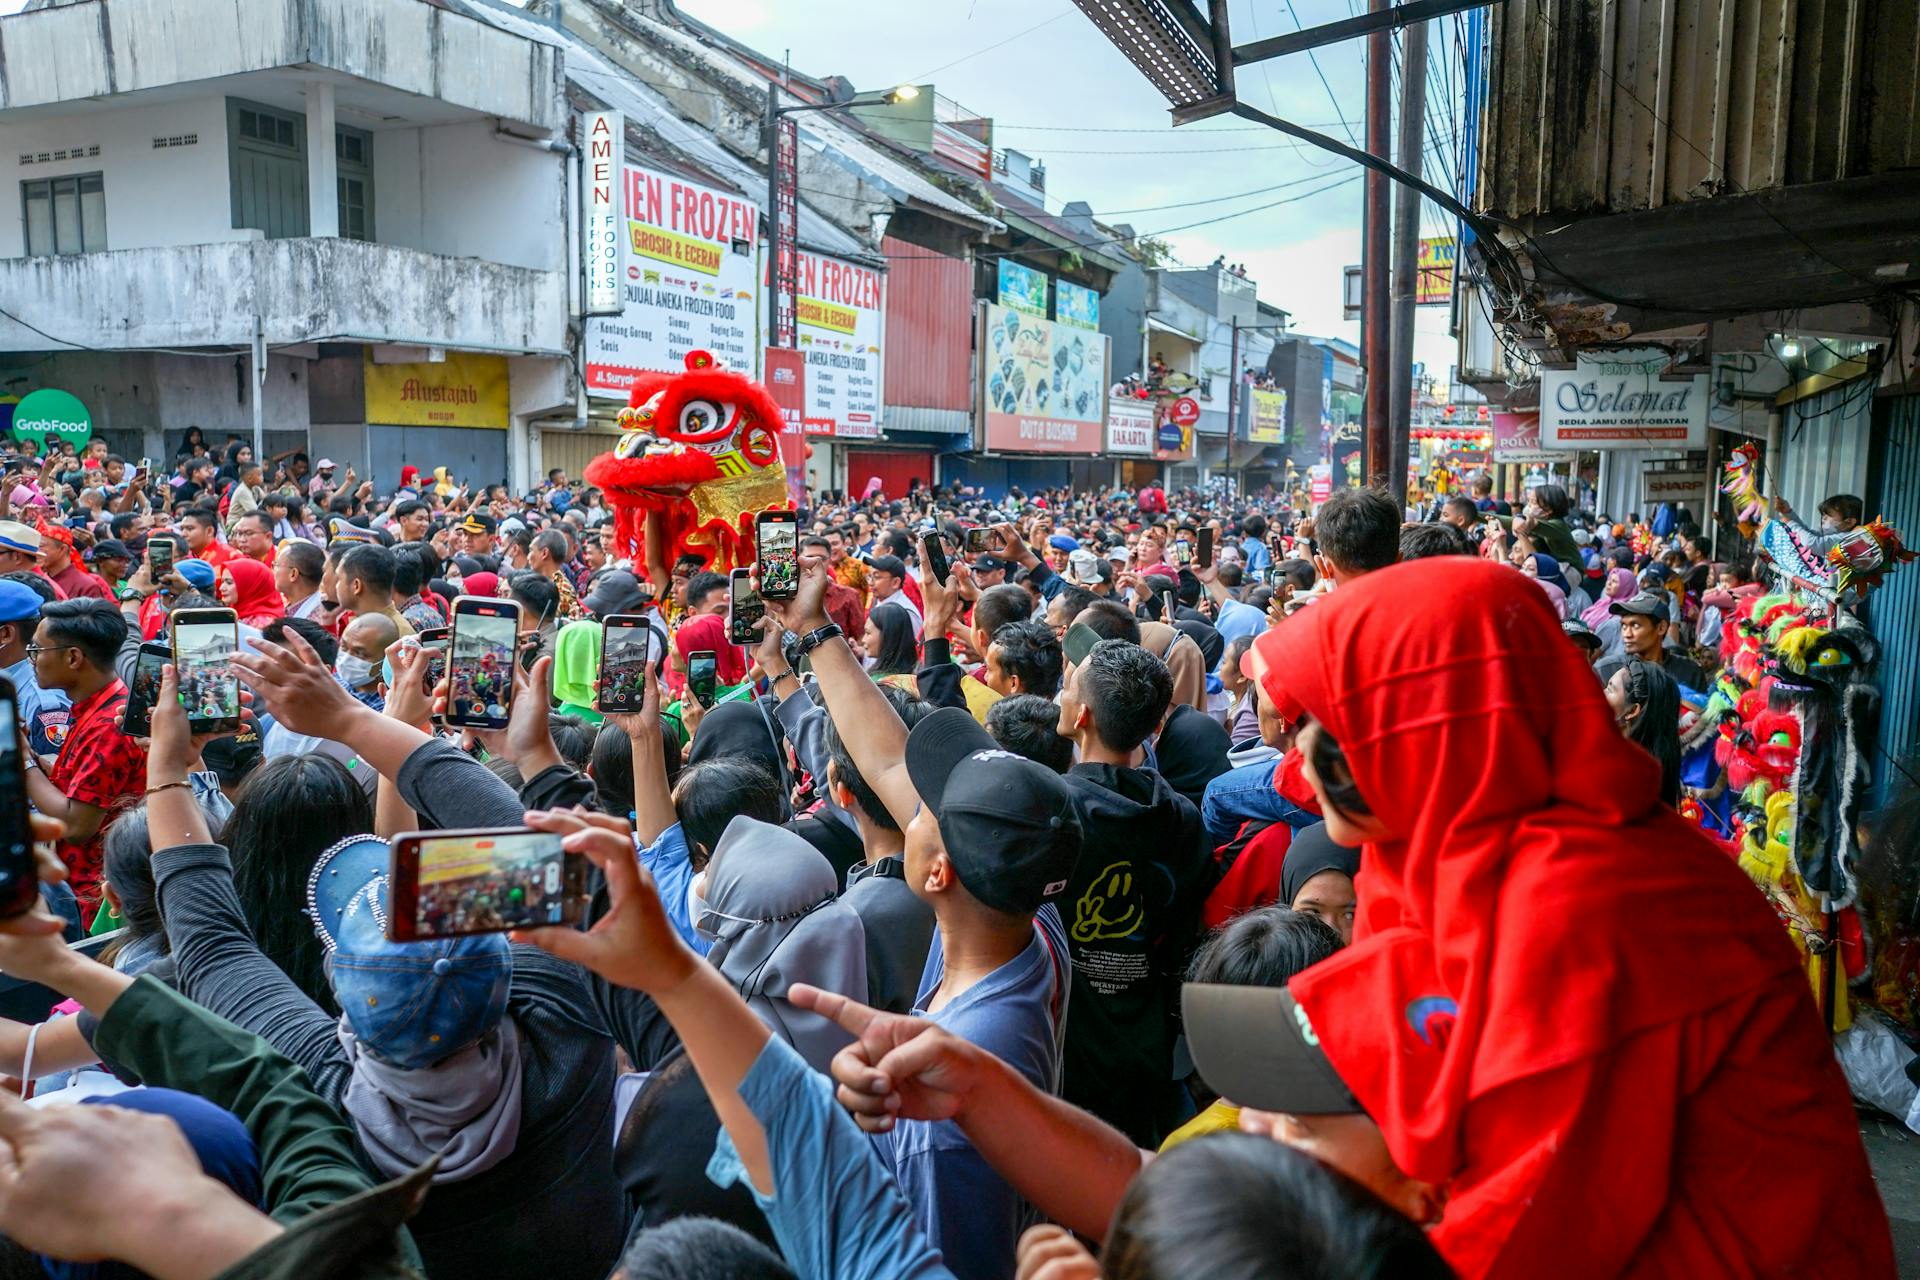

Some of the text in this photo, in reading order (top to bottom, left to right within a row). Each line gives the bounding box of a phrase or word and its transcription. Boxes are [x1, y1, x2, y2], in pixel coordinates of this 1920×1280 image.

[592, 117, 610, 204] AMEN
[671, 182, 755, 251] FROZEN
[604, 216, 616, 289] FOODS
[634, 229, 720, 269] GROSIR & ECERAN
[822, 260, 881, 312] FROZEN
[656, 292, 682, 311] ANEKA
[685, 297, 713, 316] FROZEN
[715, 302, 735, 320] FOOD
[601, 322, 652, 341] Kentang Goreng
[400, 378, 477, 405] Mustajab
[1557, 380, 1690, 413] Selamat
[16, 418, 88, 432] GrabFood
[1112, 429, 1147, 446] JAKARTA
[1649, 481, 1702, 492] SHARP
